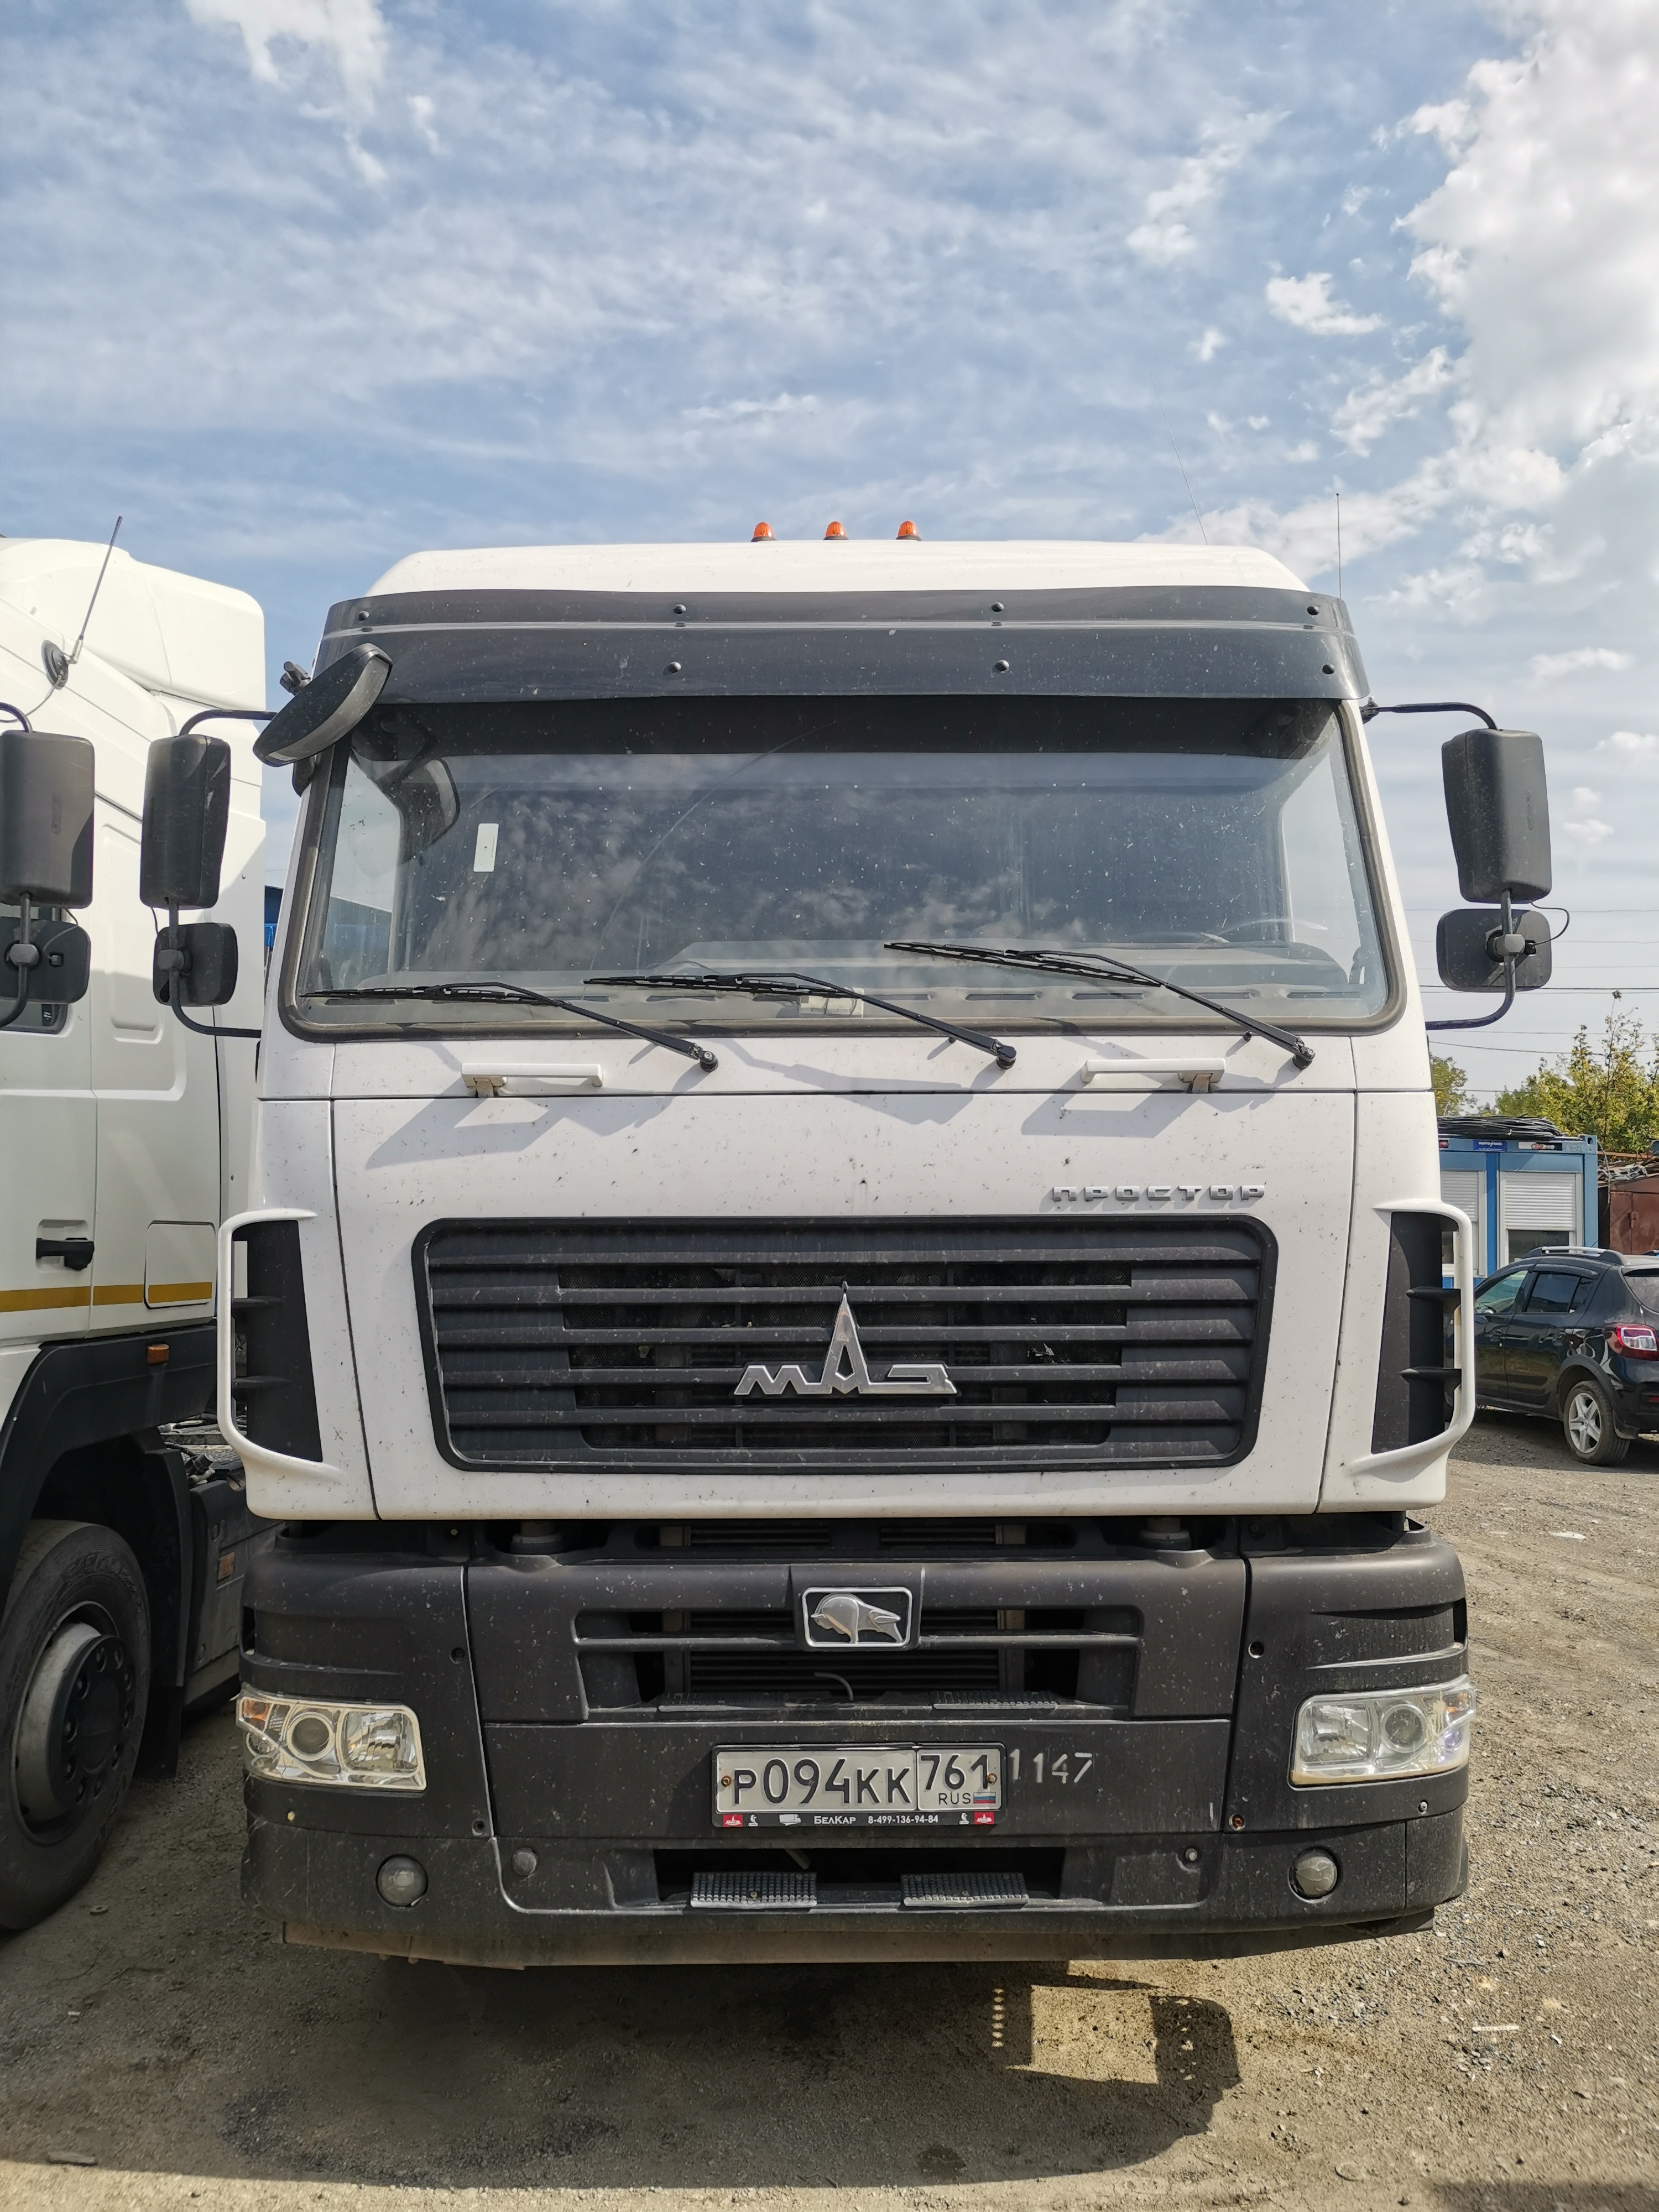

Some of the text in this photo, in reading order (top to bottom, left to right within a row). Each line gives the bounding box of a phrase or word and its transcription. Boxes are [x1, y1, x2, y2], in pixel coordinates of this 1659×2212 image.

[1052, 1185, 1265, 1202] ПРОСТОР
[921, 1754, 989, 1790] 761
[1010, 1749, 1093, 1784] 1147
[938, 1792, 971, 1805] RUS
[868, 1814, 939, 1824] 8-499-136-94-84
